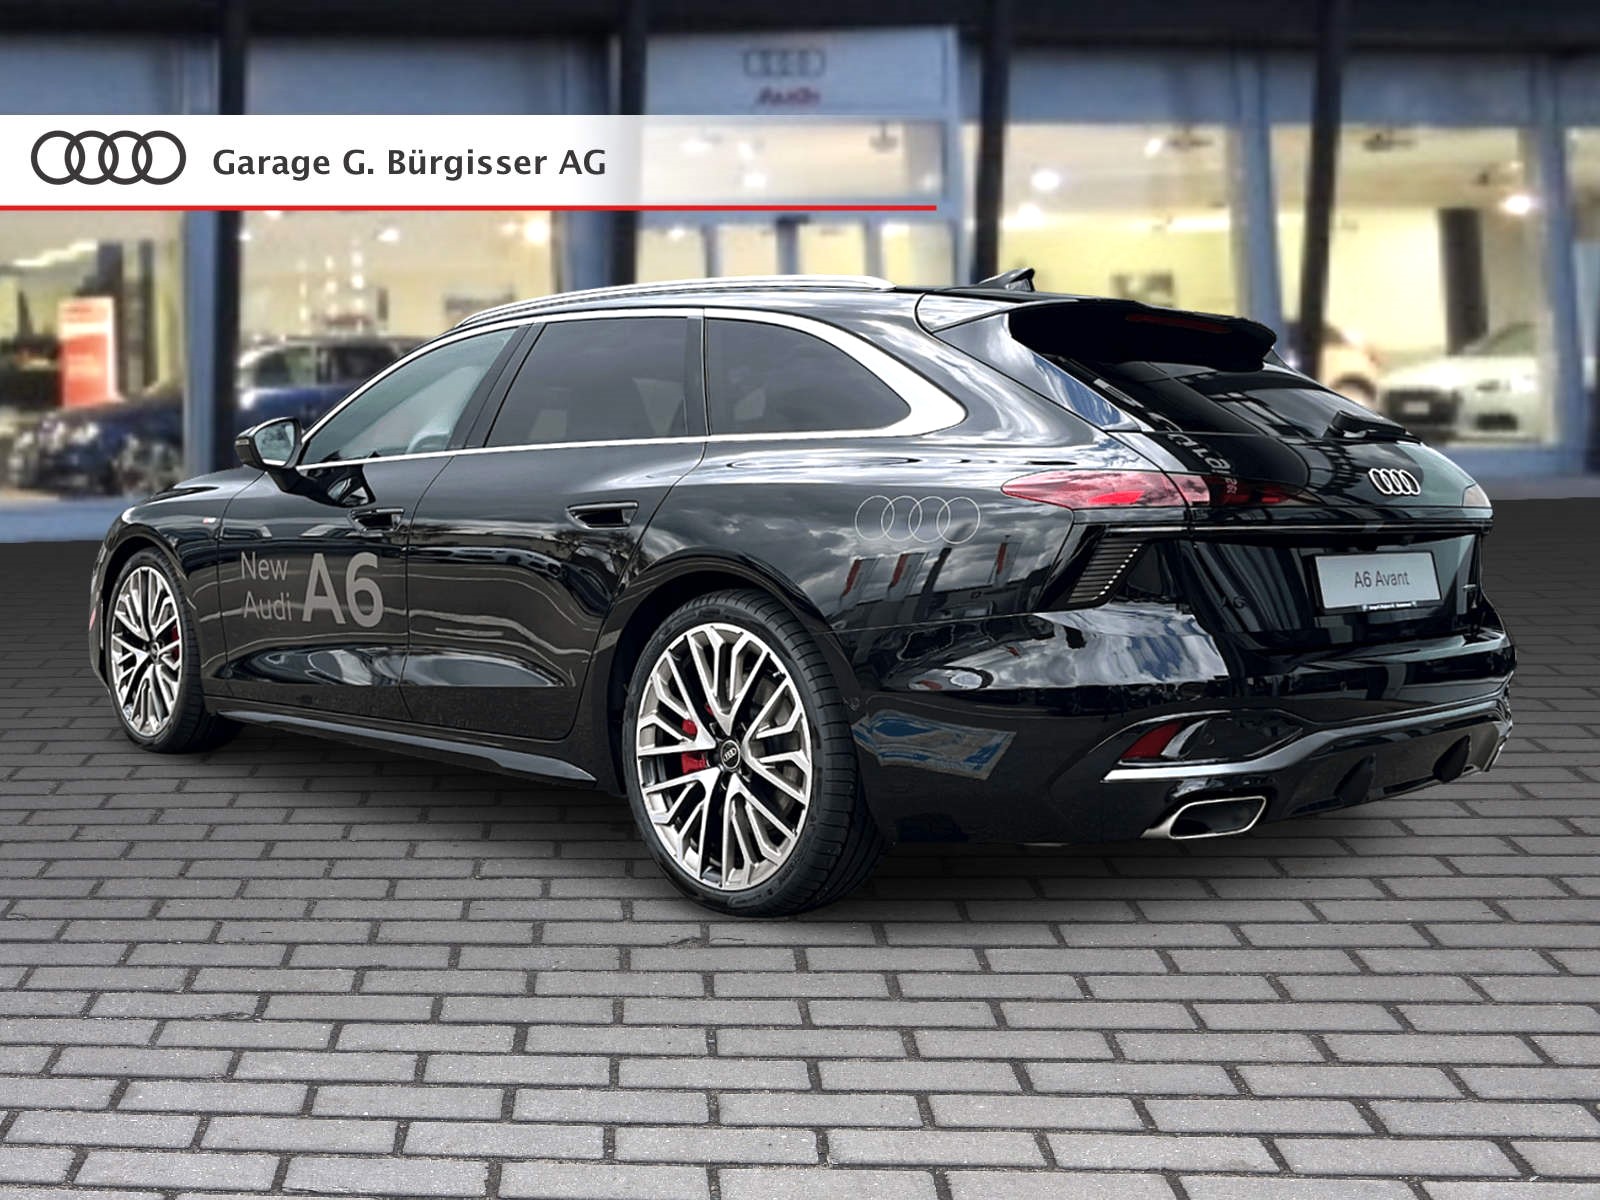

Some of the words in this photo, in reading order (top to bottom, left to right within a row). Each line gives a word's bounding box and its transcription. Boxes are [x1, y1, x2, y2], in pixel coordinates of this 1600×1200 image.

[240, 551, 288, 581] New
[1354, 571, 1373, 588] A6
[1375, 570, 1410, 587] Avant
[302, 551, 384, 628] A6
[243, 590, 293, 621] Audi
